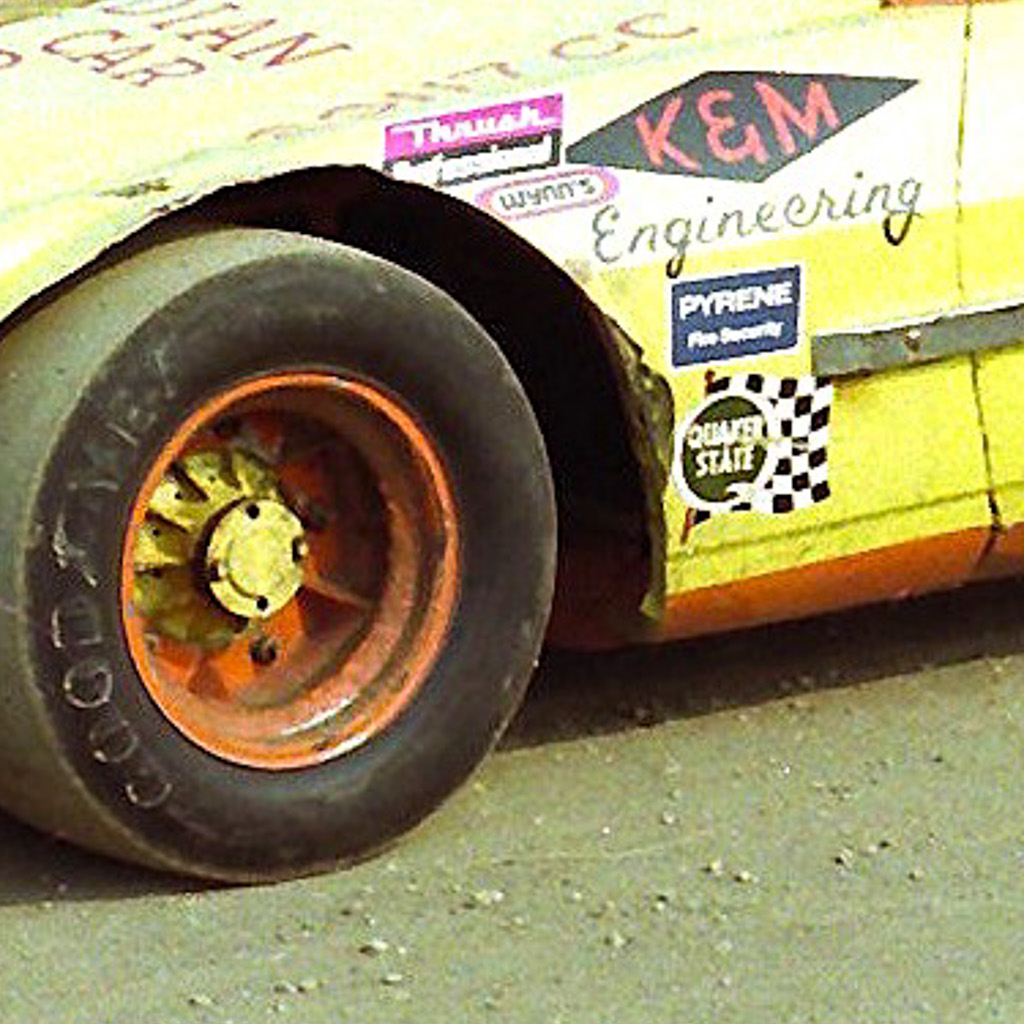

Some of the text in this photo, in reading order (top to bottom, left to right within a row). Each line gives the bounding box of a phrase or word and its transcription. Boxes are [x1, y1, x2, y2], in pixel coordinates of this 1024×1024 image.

[592, 171, 924, 280] Engineering
[678, 280, 794, 321] PYRENE
[694, 445, 756, 478] STATE
